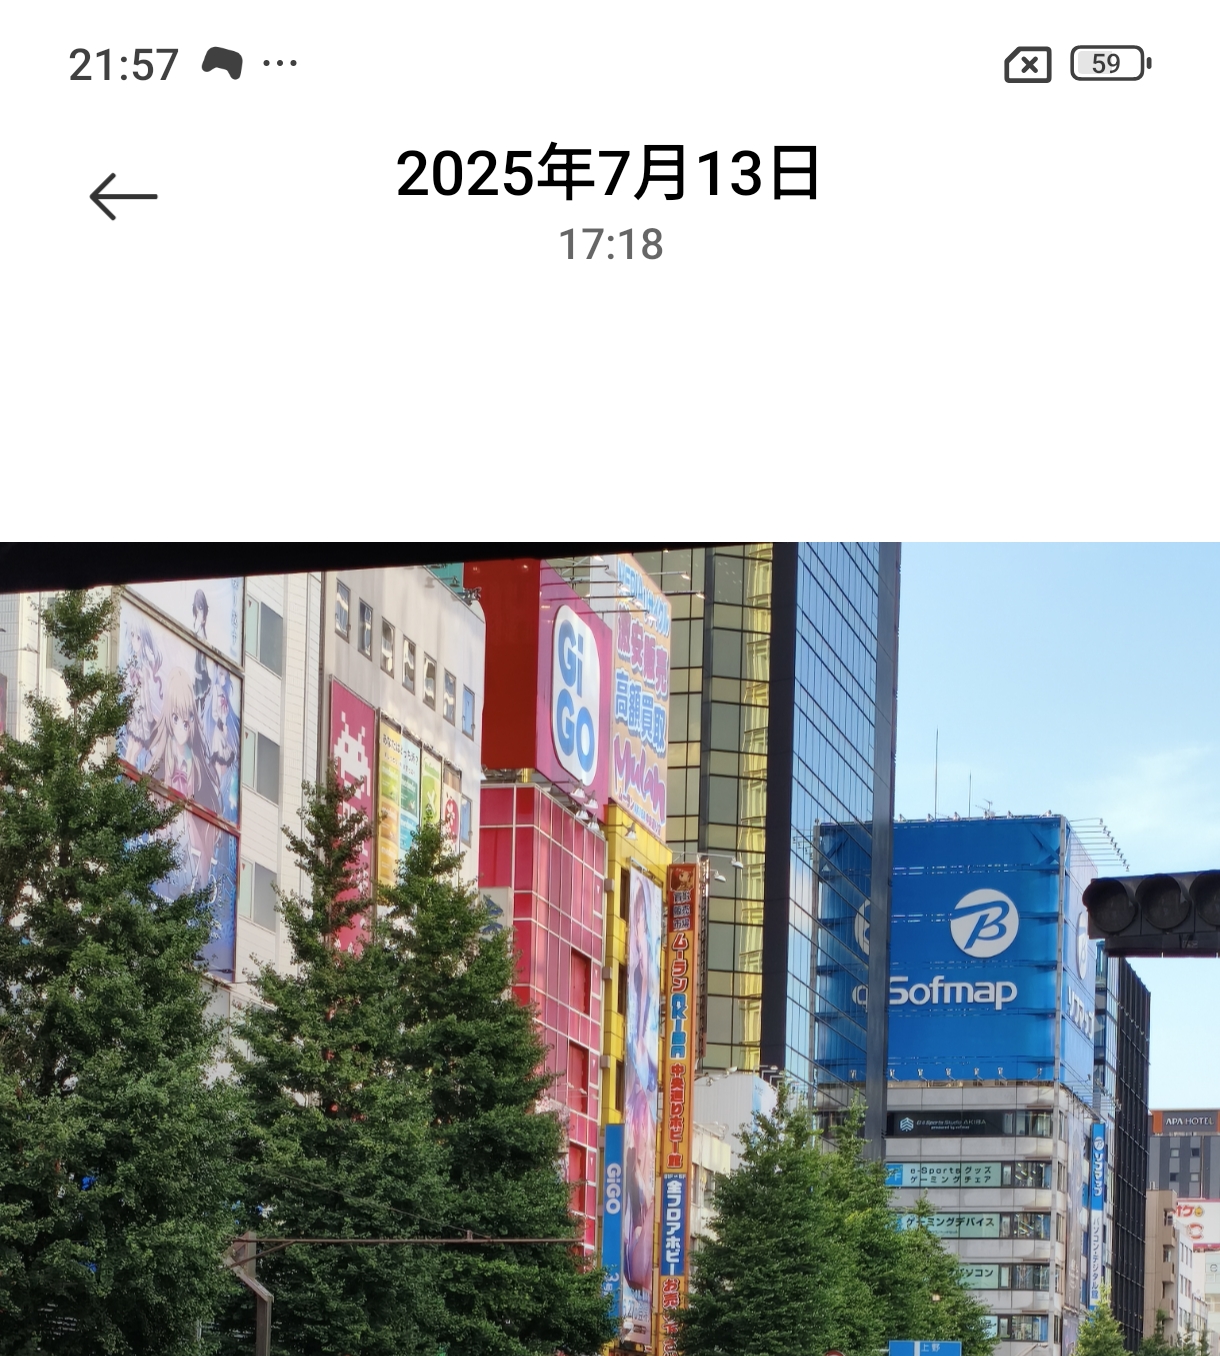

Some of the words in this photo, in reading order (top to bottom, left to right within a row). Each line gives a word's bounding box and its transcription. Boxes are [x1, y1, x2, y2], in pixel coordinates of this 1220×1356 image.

[615, 668, 666, 755] 高額買取
[889, 975, 1018, 1010] Sofmap
[1165, 1117, 1183, 1125] APA
[1185, 1117, 1214, 1125] HOTEL
[964, 1166, 992, 1175] グッズ
[606, 1162, 622, 1215] GiGO
[665, 1180, 682, 1276] 全フロアホビー
[906, 1216, 995, 1227] ゲーミングデバイス
[921, 1343, 941, 1352] 上野
